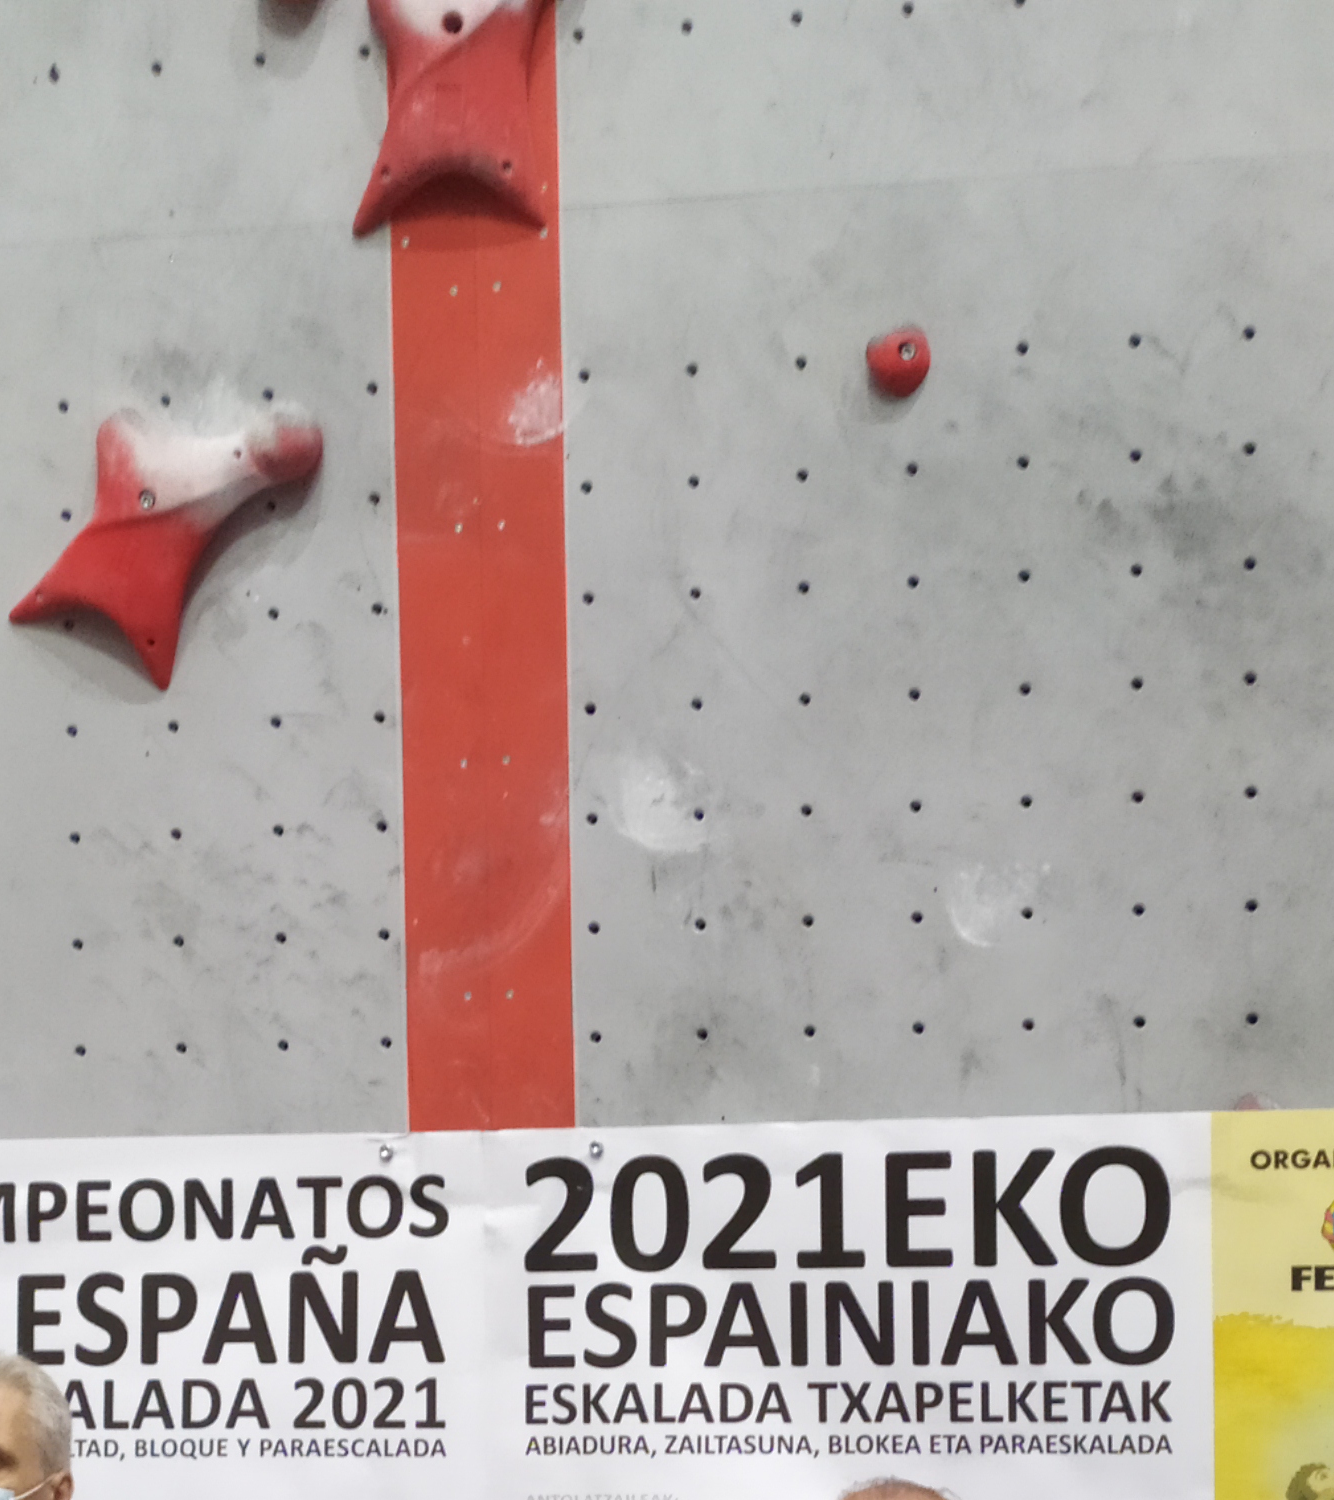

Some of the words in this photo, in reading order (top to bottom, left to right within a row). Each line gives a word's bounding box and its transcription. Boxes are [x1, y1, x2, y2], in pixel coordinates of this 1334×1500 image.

[524, 1146, 1171, 1272] 2021EKO
[17, 1245, 446, 1366] ESPAÑA
[527, 1276, 1176, 1369] ESPAINIAKO
[65, 1378, 270, 1431] ALADA
[292, 1376, 446, 1431] 2021
[525, 1381, 792, 1424] ESKALADA
[808, 1380, 1172, 1423] TXAPELKETAK
[133, 1438, 229, 1462] BLOQUE
[237, 1438, 250, 1458] Y
[259, 1437, 447, 1458] PARAESCALADA
[525, 1434, 657, 1459] ABIADURA,
[664, 1434, 820, 1458] ZAILTASUNA,
[828, 1434, 921, 1456] BLOKEA
[929, 1434, 971, 1456] ETA
[979, 1434, 1173, 1456] PARAESKALADA
